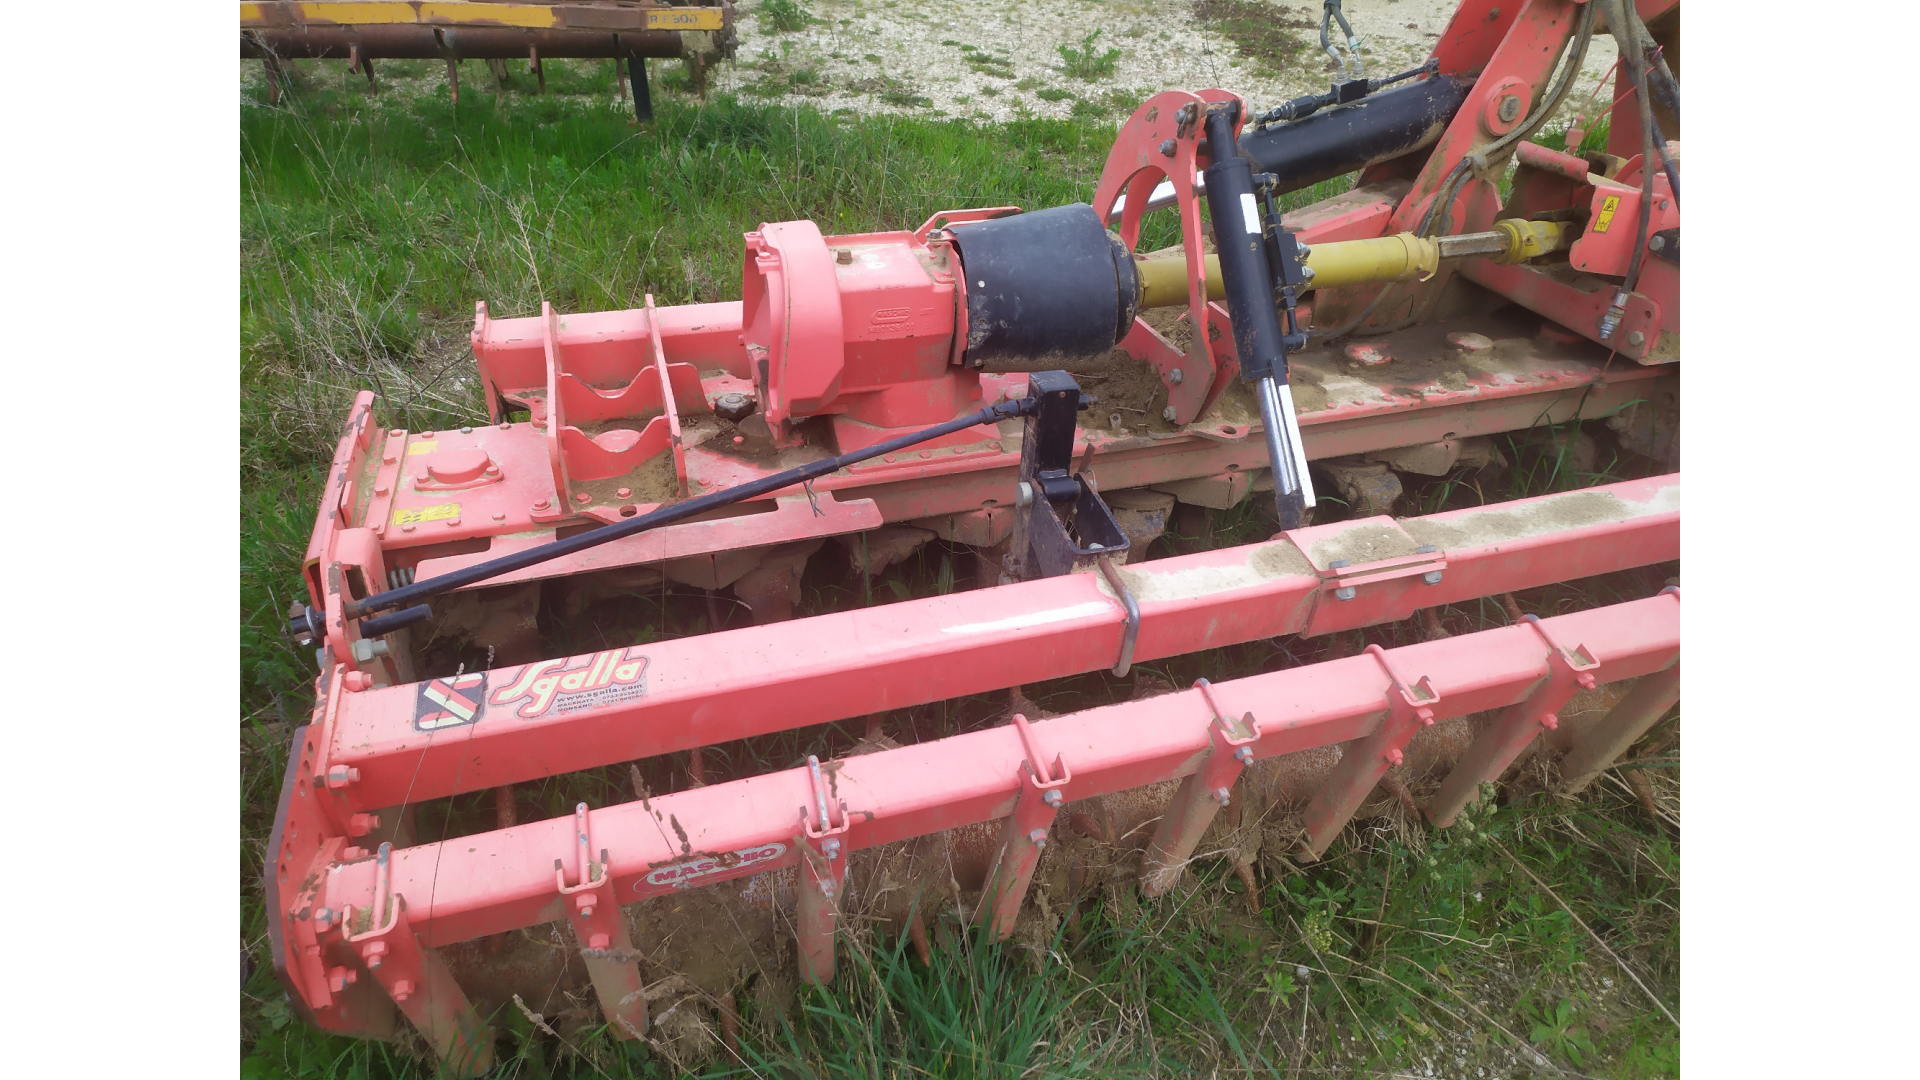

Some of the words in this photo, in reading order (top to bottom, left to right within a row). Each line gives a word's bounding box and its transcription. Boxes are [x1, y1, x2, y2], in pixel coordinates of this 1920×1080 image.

[496, 650, 642, 713] Sgalla
[557, 684, 643, 702] www.sgalla.com
[654, 847, 777, 883] MASHIO
